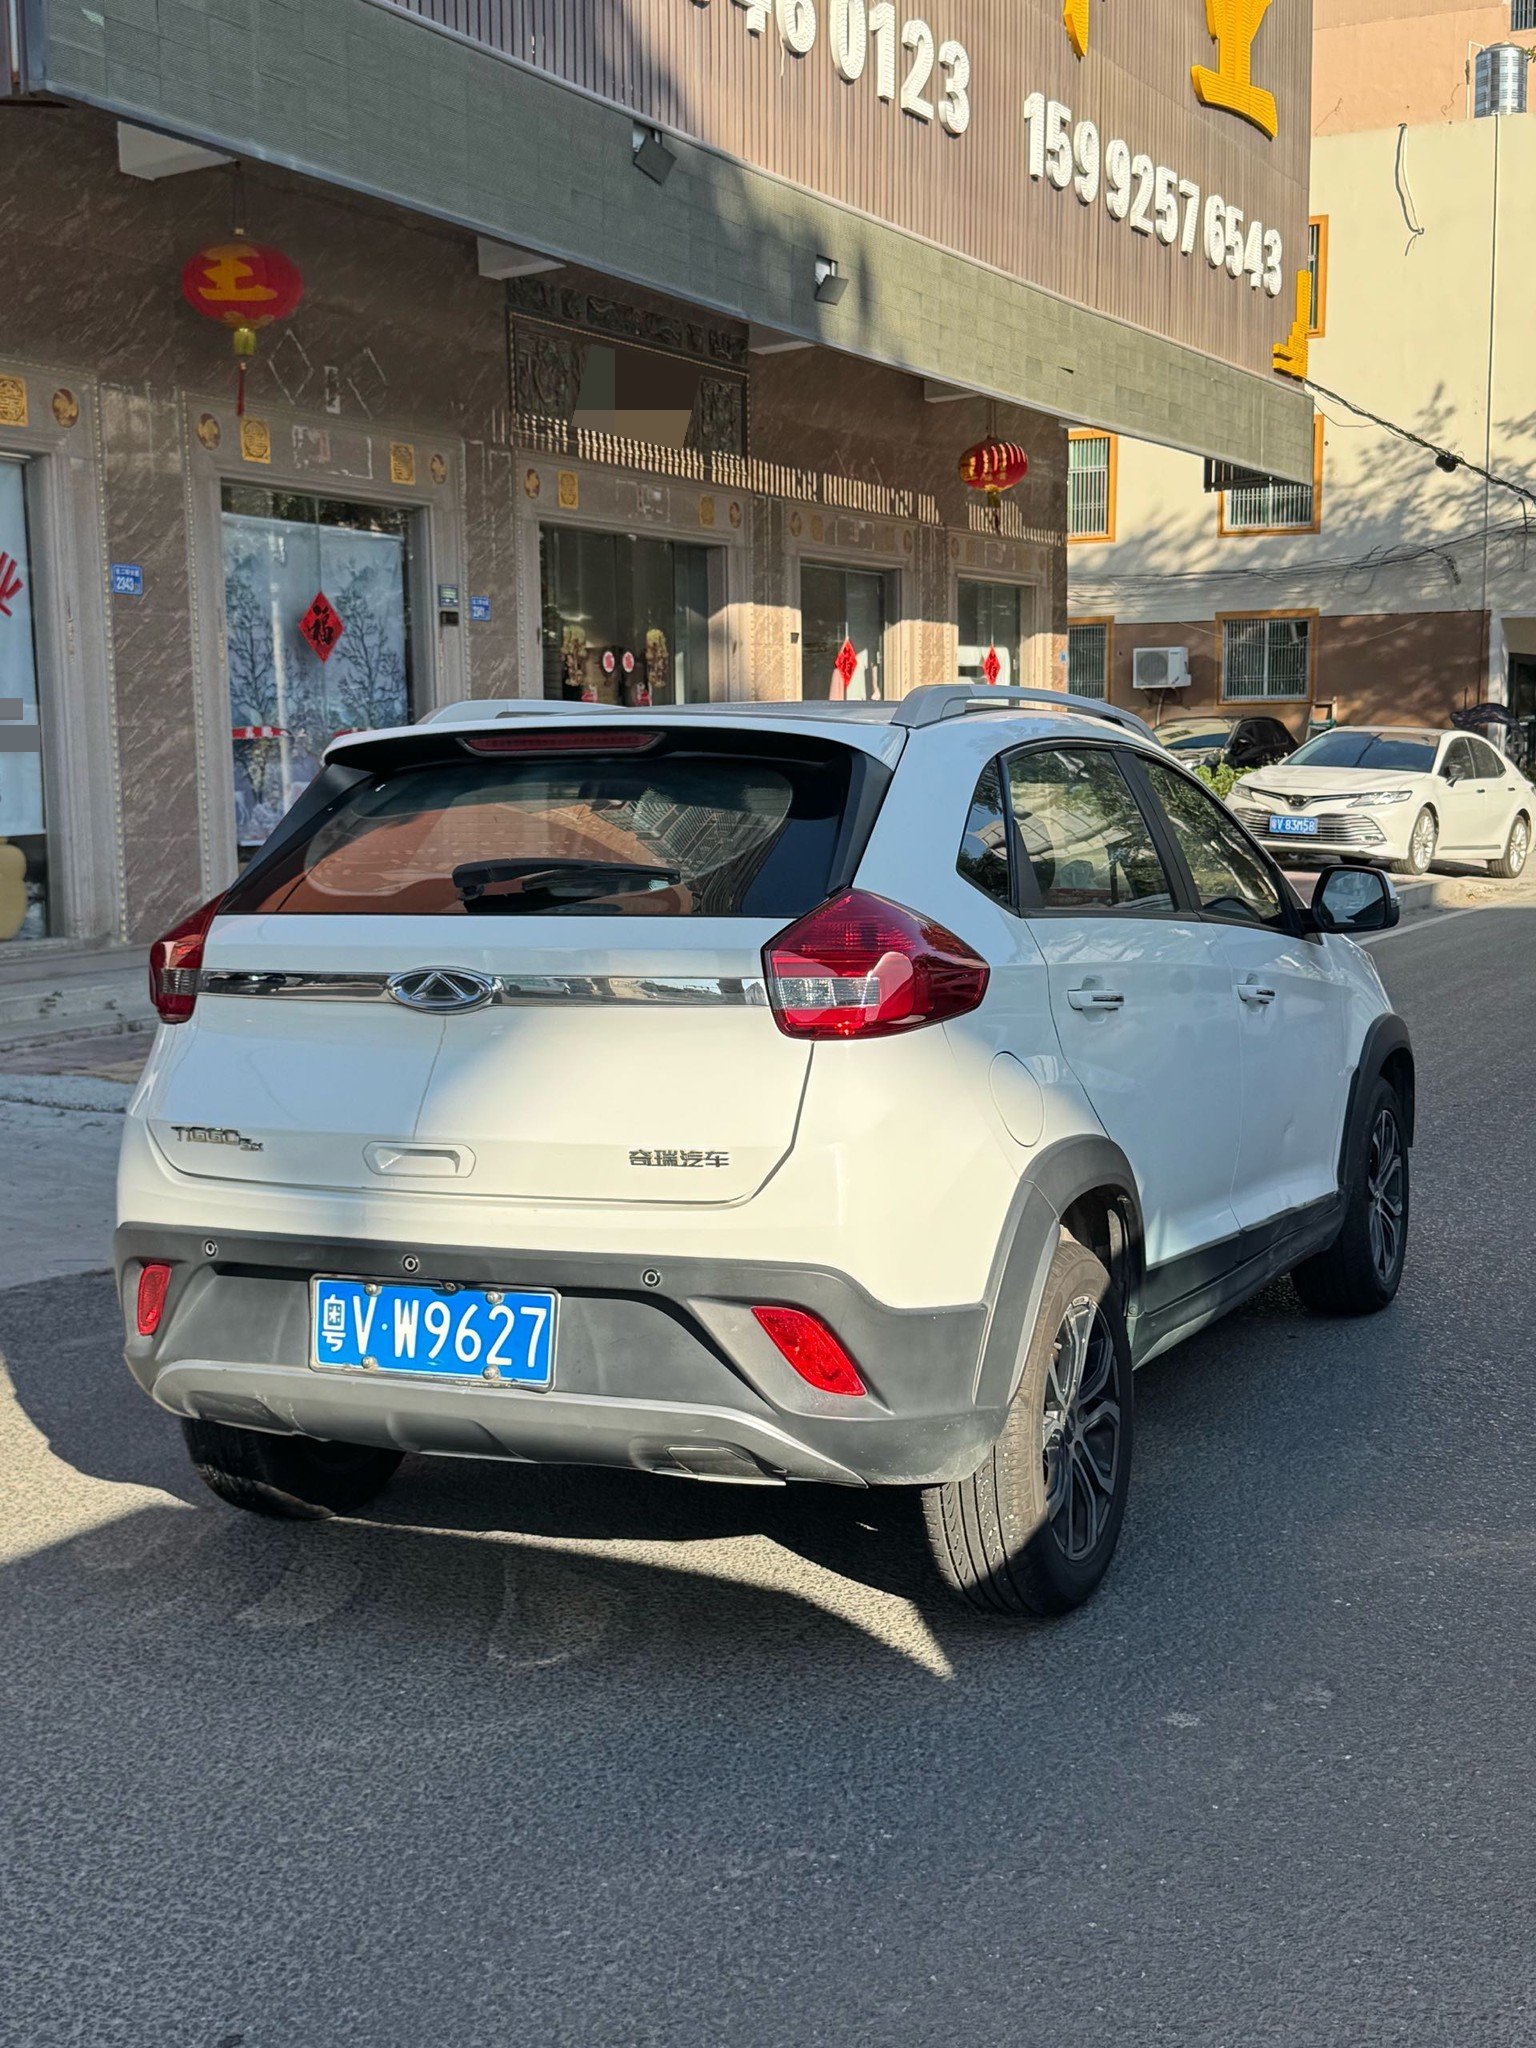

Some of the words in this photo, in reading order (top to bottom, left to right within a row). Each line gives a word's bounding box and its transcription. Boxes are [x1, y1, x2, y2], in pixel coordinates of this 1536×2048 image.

[829, 0, 970, 134] 0123
[1023, 92, 1099, 204] 159
[1106, 139, 1200, 254] 9257
[1204, 194, 1283, 297] 6543
[628, 1148, 730, 1168] 奇瑞汽车
[321, 1293, 548, 1368] 粤V·W9627
